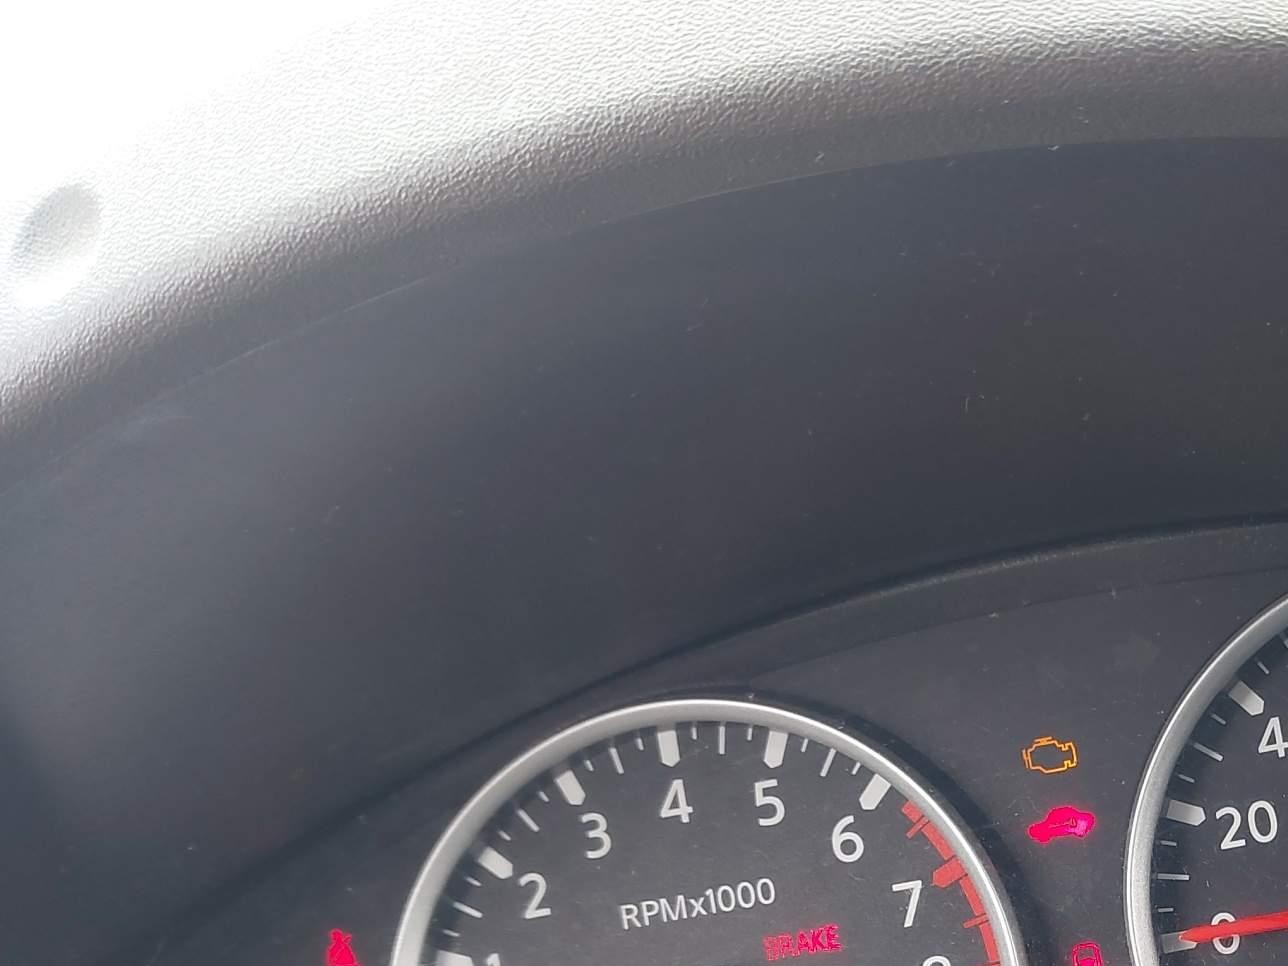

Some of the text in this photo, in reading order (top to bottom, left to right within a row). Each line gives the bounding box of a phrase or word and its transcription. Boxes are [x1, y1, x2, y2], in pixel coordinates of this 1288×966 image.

[659, 779, 693, 825] 4
[754, 779, 786, 827] 5
[1215, 800, 1279, 851] 20
[582, 812, 612, 860] 3
[831, 815, 865, 863] 6
[519, 872, 553, 920] 2
[620, 877, 777, 931] RPMx1000
[892, 879, 923, 929] 7
[763, 923, 844, 962] BRAKE
